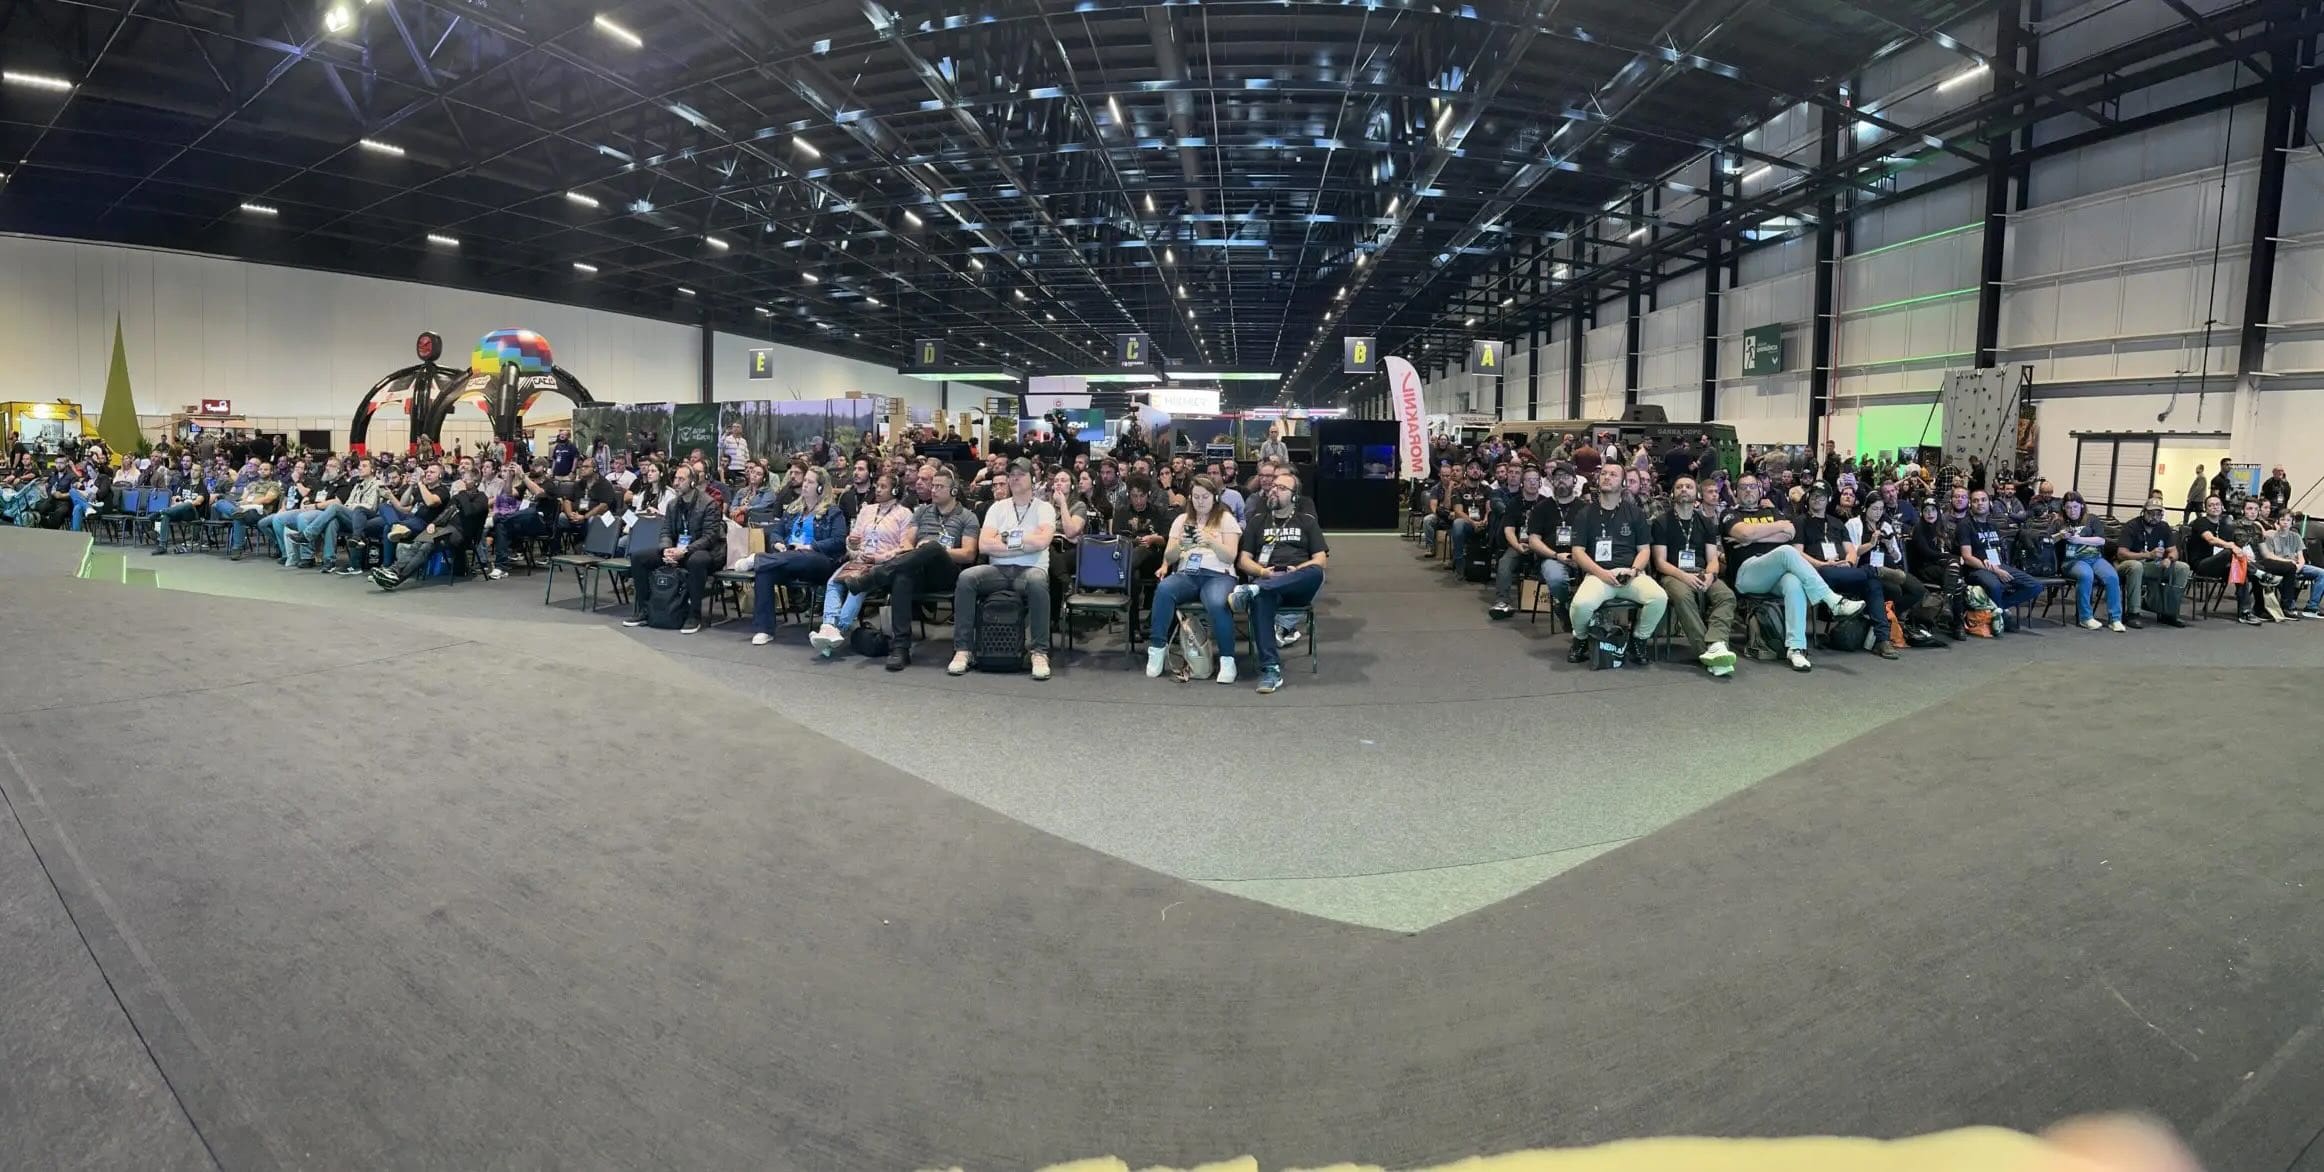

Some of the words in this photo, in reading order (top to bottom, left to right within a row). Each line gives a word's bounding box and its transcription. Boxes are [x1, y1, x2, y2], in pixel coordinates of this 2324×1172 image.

[924, 346, 935, 364] D
[1127, 341, 1139, 360] C
[1354, 345, 1367, 363] B
[1481, 349, 1494, 366] A
[757, 355, 765, 371] E
